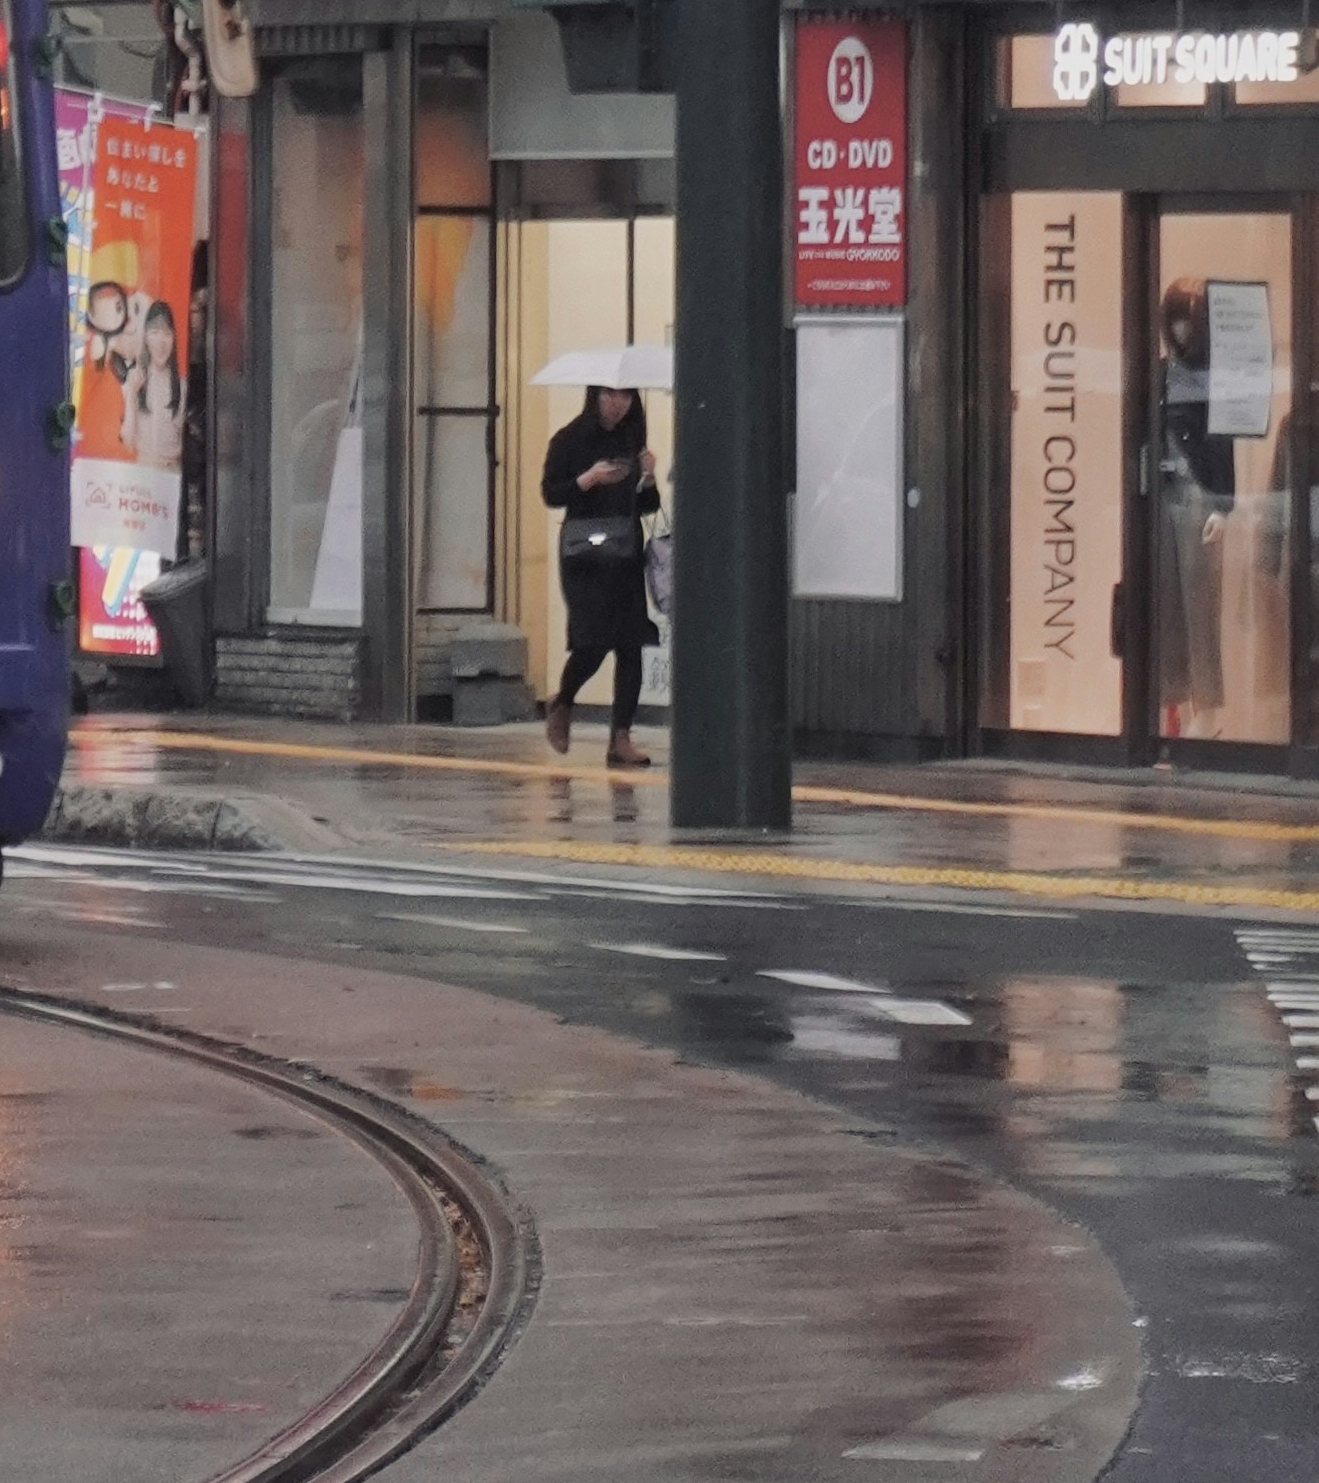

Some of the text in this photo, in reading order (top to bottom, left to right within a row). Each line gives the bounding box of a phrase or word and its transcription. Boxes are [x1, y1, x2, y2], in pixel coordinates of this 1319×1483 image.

[834, 55, 866, 106] B1
[1104, 31, 1300, 86] SUIT SQUARE
[797, 186, 903, 245] 玉光堂
[1043, 214, 1078, 663] THE SUIT COMPANY
